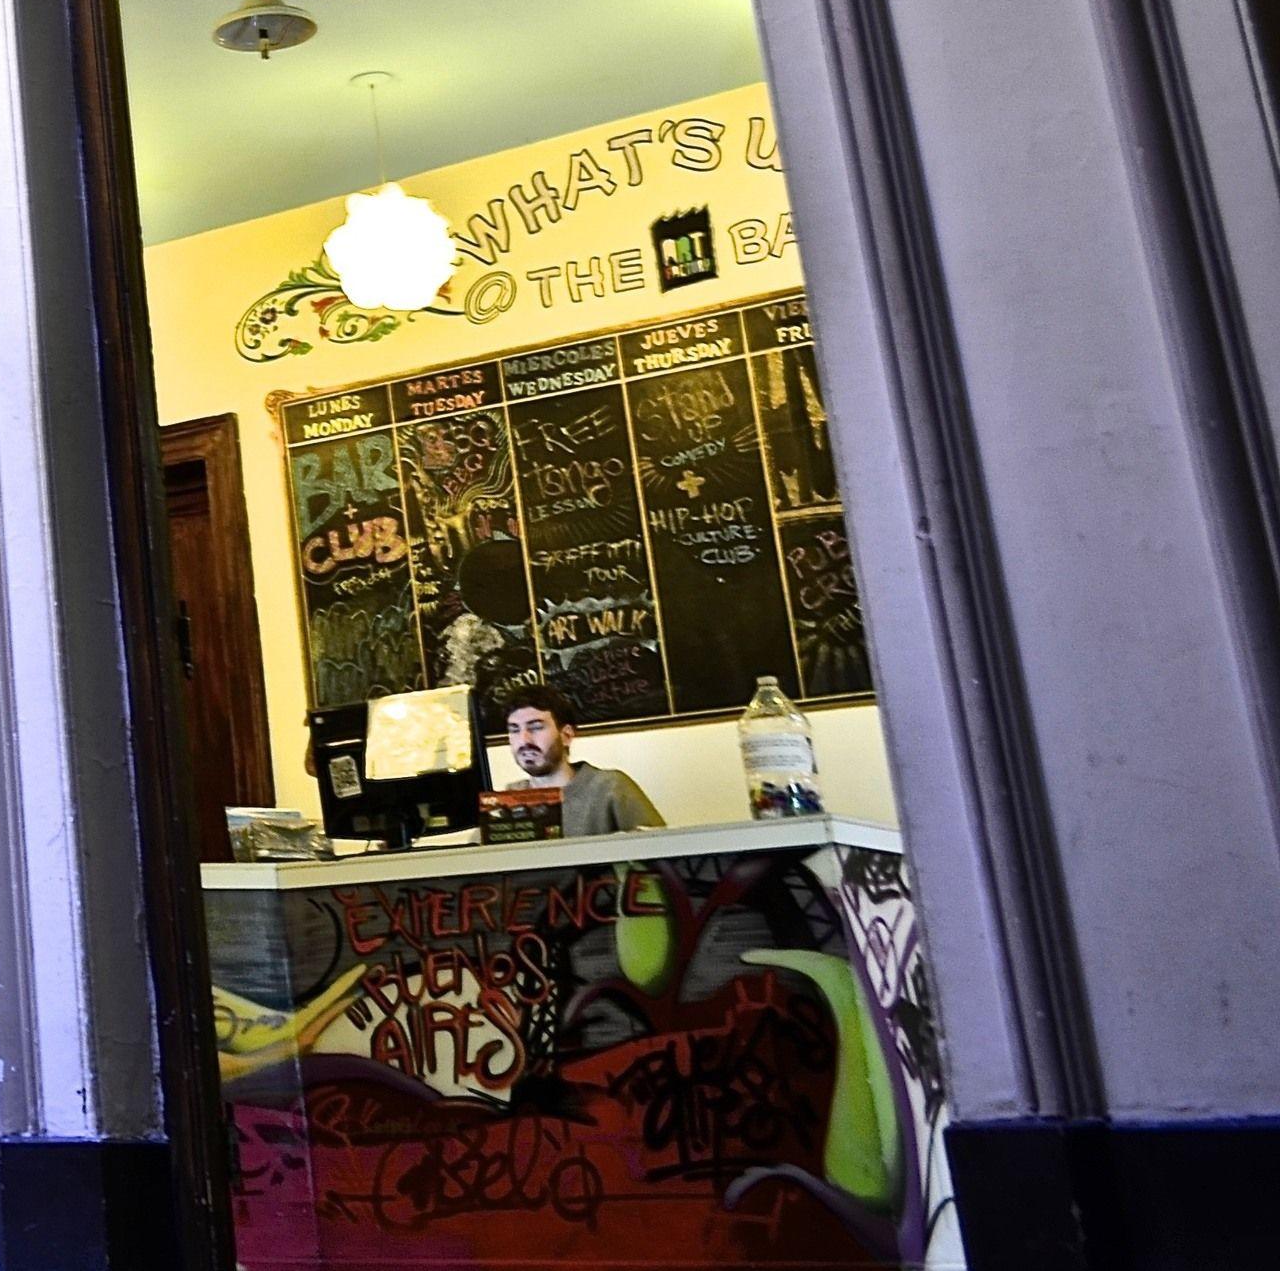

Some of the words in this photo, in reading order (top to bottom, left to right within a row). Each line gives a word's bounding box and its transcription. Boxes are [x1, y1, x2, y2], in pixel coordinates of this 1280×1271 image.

[454, 118, 725, 265] WHAT'S
[662, 232, 706, 266] ART
[527, 249, 645, 308] THE
[641, 319, 718, 350] JUEVES
[503, 341, 615, 376] MIERCOLES
[634, 337, 732, 373] THURSDAY
[407, 370, 483, 396] MARTES
[508, 363, 616, 396] WEDNESDAY
[308, 395, 361, 418] LUNES
[411, 390, 485, 416] TUESDAY
[304, 413, 373, 439] MONDAY
[514, 404, 617, 461] FREE
[661, 438, 725, 467] COMEDY
[295, 433, 400, 540] BAR
[650, 497, 753, 534] HIP-HOP
[302, 516, 408, 575] CLUB
[583, 565, 642, 586] TOUR
[548, 615, 578, 645] ART
[586, 608, 647, 636] WALK
[344, 871, 667, 955] EXPERIENCE
[362, 932, 555, 1016] BUENOS
[370, 984, 527, 1090] AIRES
